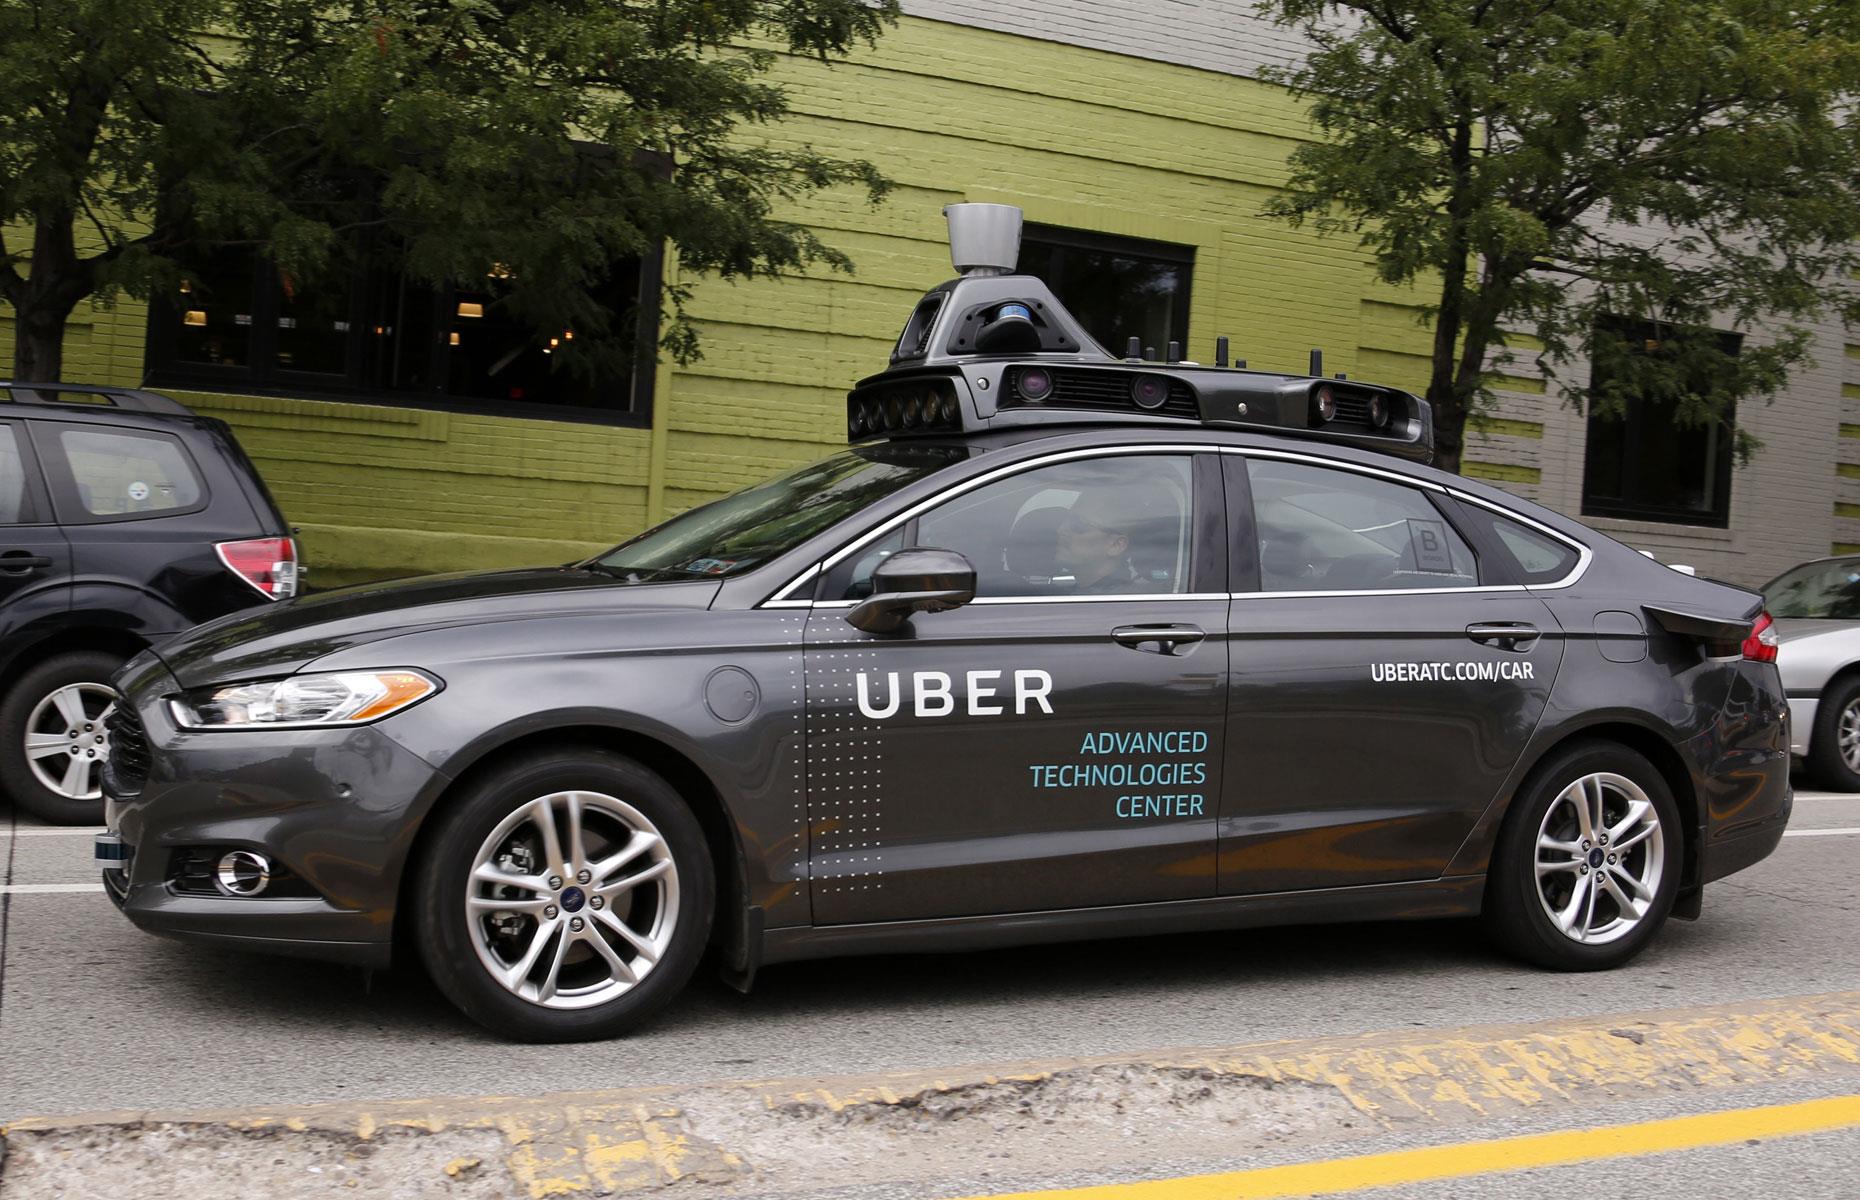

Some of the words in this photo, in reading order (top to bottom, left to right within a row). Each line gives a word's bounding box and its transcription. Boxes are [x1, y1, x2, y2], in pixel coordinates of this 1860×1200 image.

[1421, 530, 1439, 551] B
[1371, 662, 1534, 682] UBERATC.COM/CAR
[856, 669, 1054, 719] UBER
[1080, 731, 1208, 754] ADVANCED
[1029, 763, 1206, 787] TECHNOLOGIES
[1116, 795, 1204, 817] CENTER
